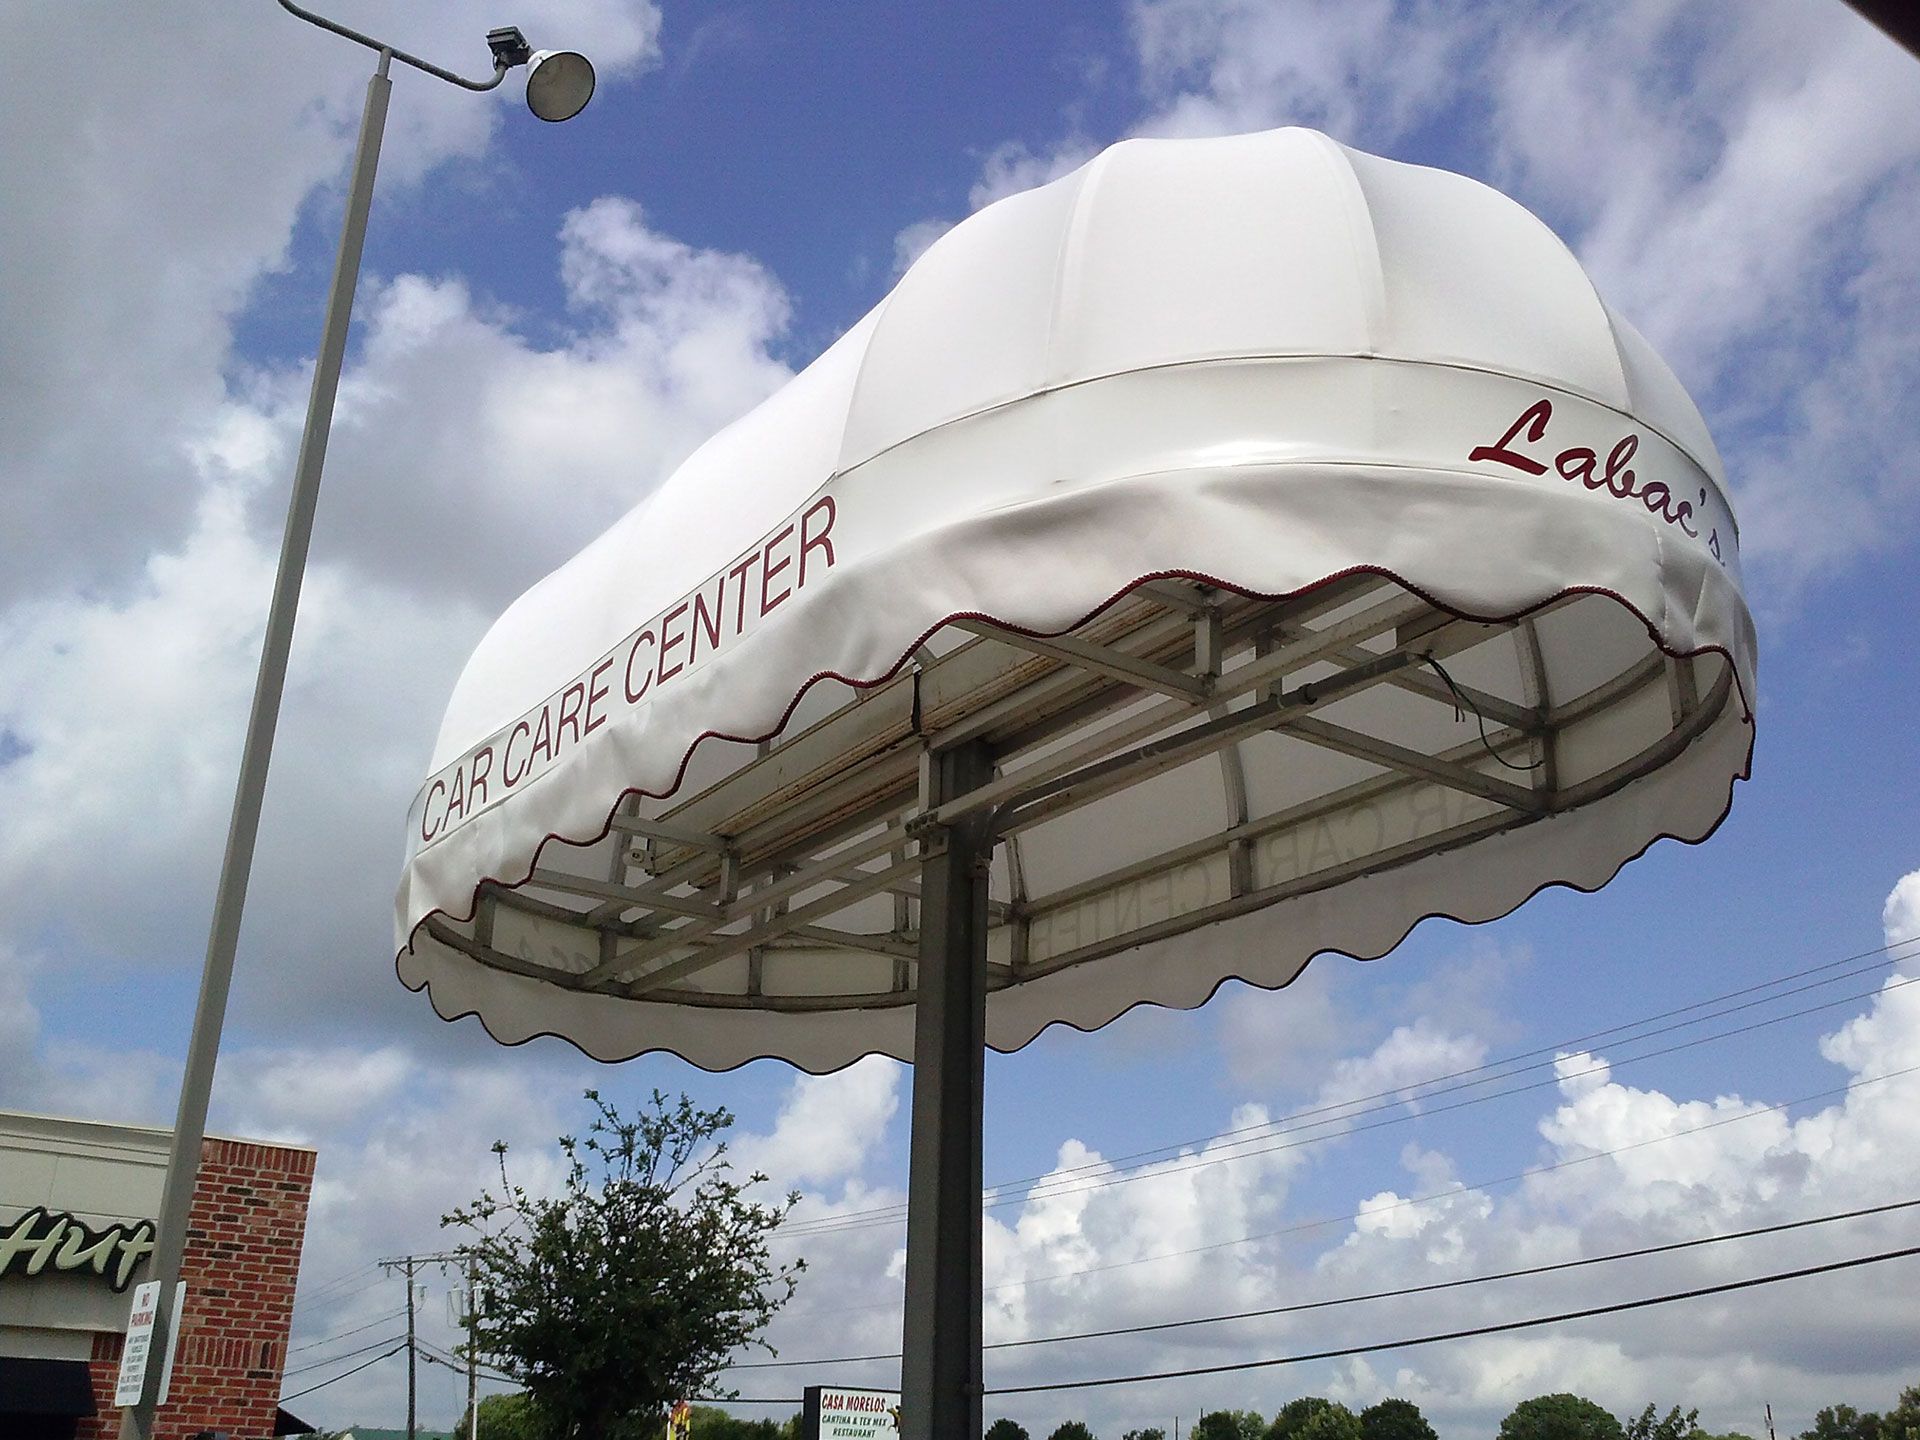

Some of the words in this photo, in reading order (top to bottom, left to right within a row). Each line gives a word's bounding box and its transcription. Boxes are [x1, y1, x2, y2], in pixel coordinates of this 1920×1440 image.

[1467, 398, 1726, 568] Labac's
[421, 745, 494, 842] CAR
[502, 656, 615, 789] CARE
[624, 495, 837, 705] CENTER
[822, 1394, 844, 1410] CASA
[846, 1395, 886, 1413] MORELOS
[822, 1414, 851, 1425] CANTINA
[860, 1416, 871, 1426] TEX
[832, 1427, 876, 1438] RESTAURANT
